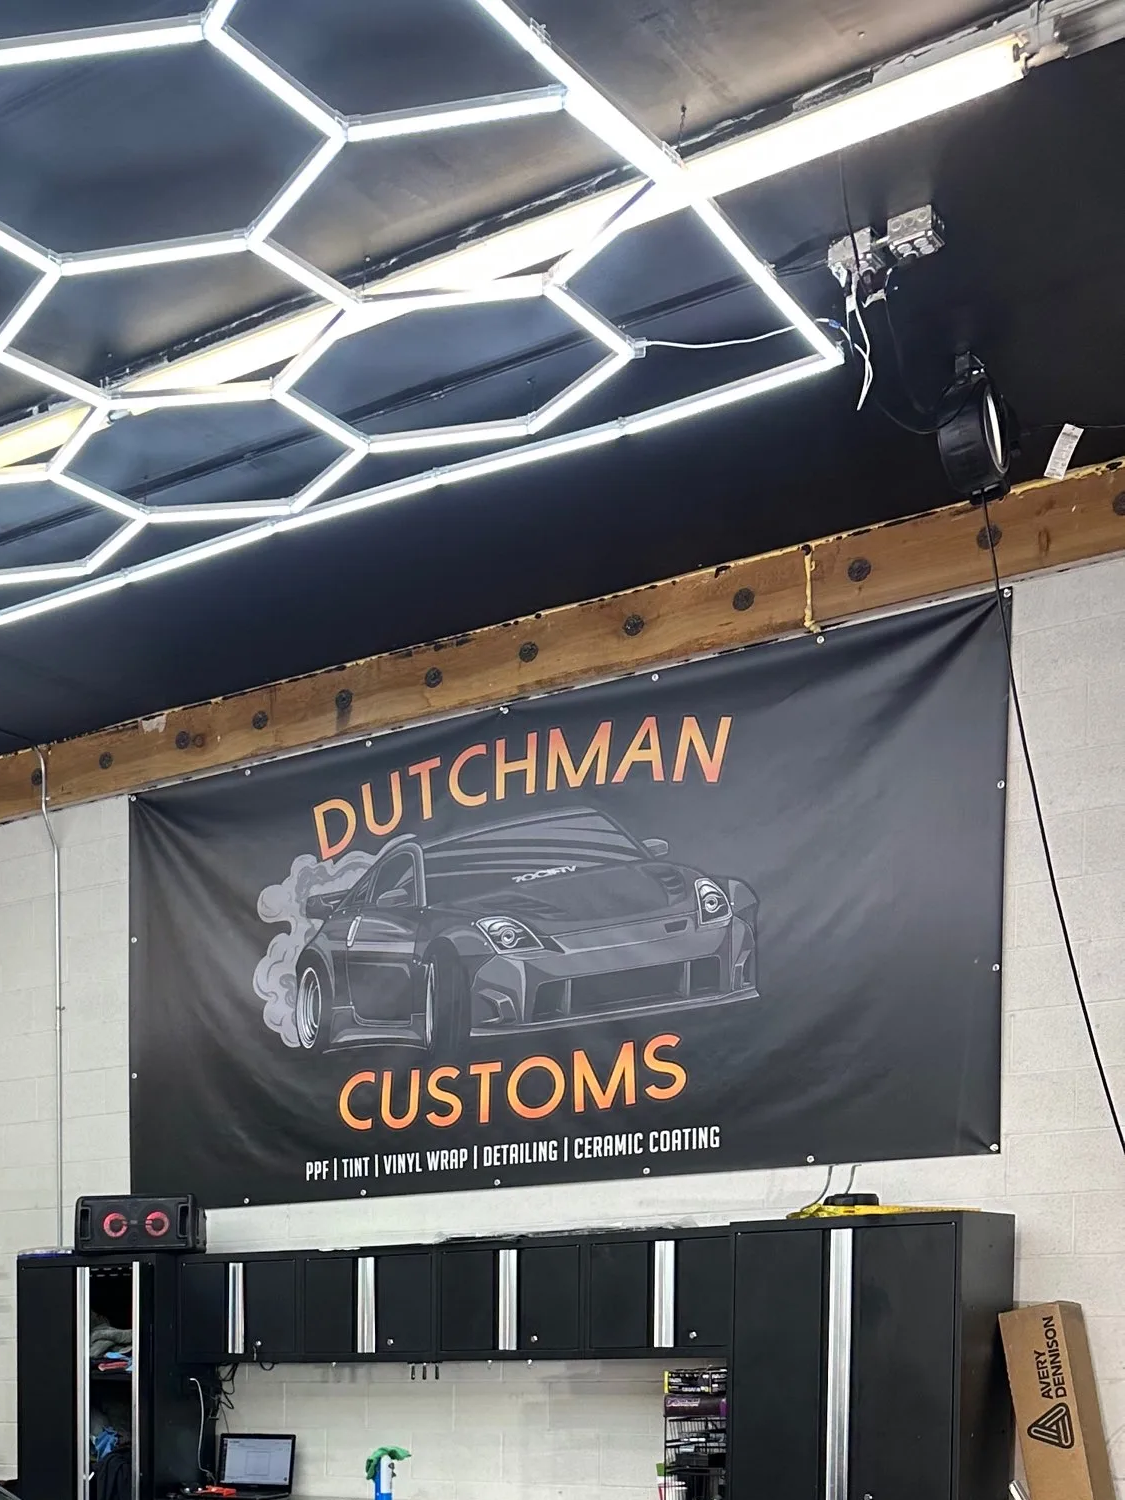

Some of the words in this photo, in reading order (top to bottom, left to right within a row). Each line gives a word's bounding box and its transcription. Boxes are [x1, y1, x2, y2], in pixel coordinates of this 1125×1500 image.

[313, 714, 733, 861] DUTCHMAN
[338, 1033, 688, 1131] CUSTOMS
[305, 1160, 330, 1181] PPF
[342, 1156, 370, 1179] TINT
[383, 1152, 423, 1174] VINYL
[426, 1148, 469, 1172] WRAP
[483, 1139, 558, 1167] DETAILING
[574, 1132, 644, 1160] CERAMIC
[649, 1126, 721, 1153] COATING
[1034, 1350, 1054, 1400] AVERY
[1042, 1315, 1068, 1399] DENNISON
